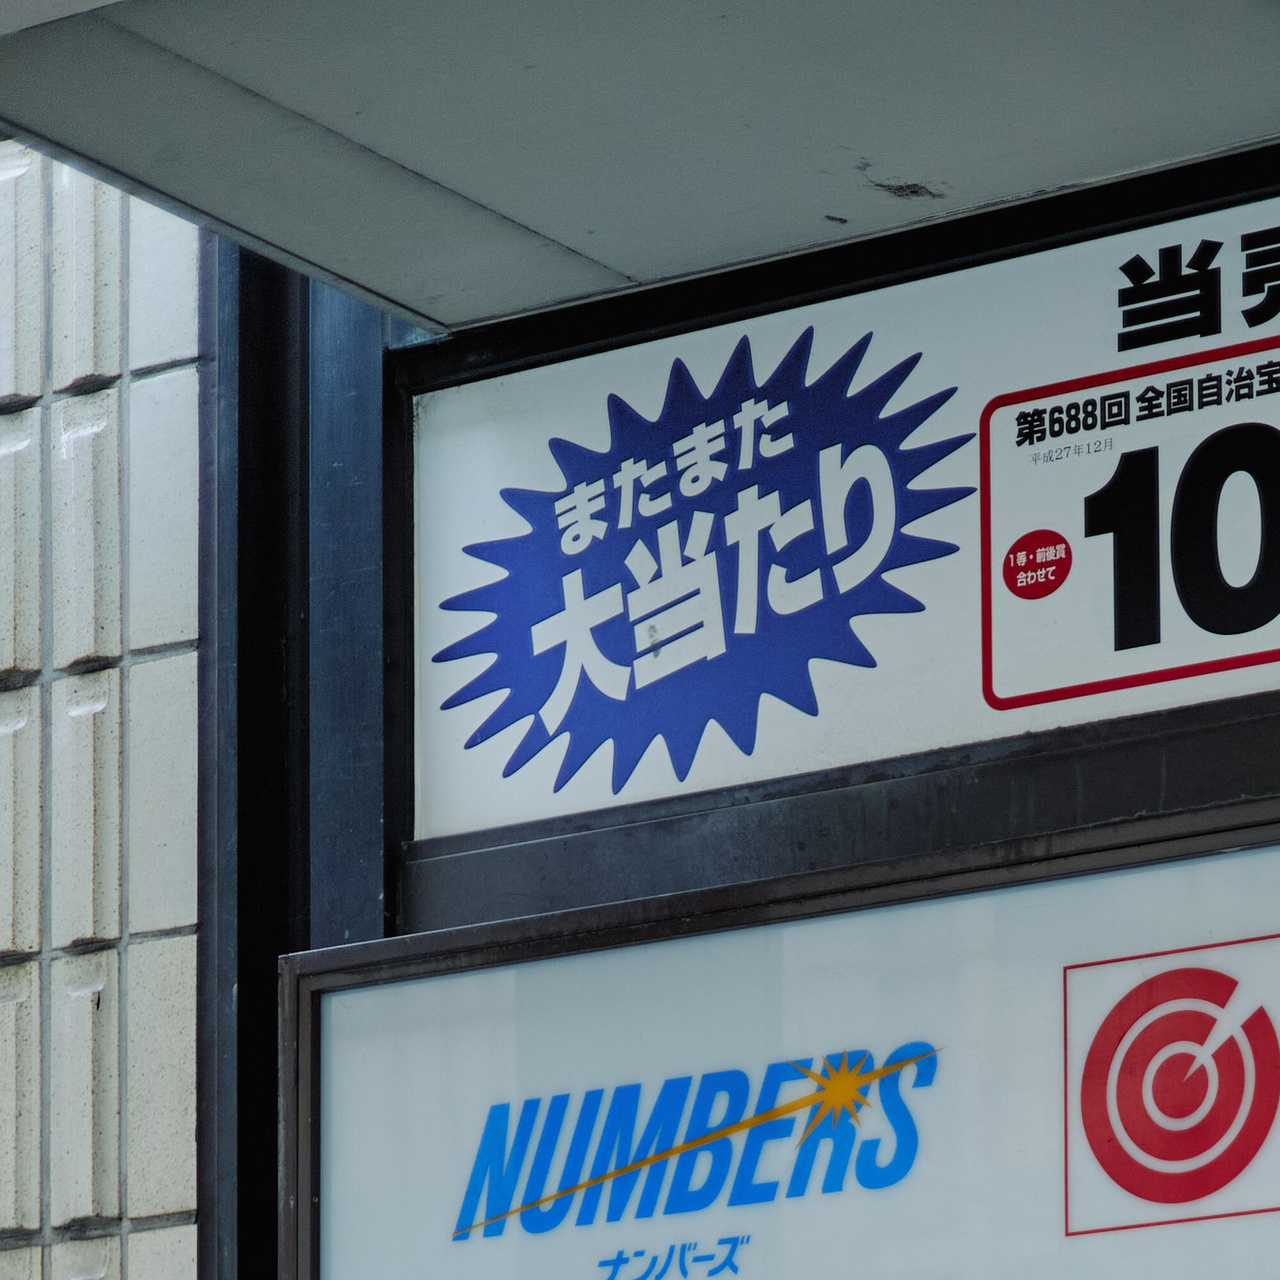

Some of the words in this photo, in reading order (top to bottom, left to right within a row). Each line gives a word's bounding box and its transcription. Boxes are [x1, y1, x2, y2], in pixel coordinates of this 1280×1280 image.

[1015, 391, 1132, 446] 第688回
[1029, 437, 1115, 467] 平成27年12月
[554, 399, 795, 557] またまた
[531, 443, 897, 736] 大当たり
[1016, 565, 1056, 588] 合わせて
[451, 1039, 940, 1242] NUMBERS
